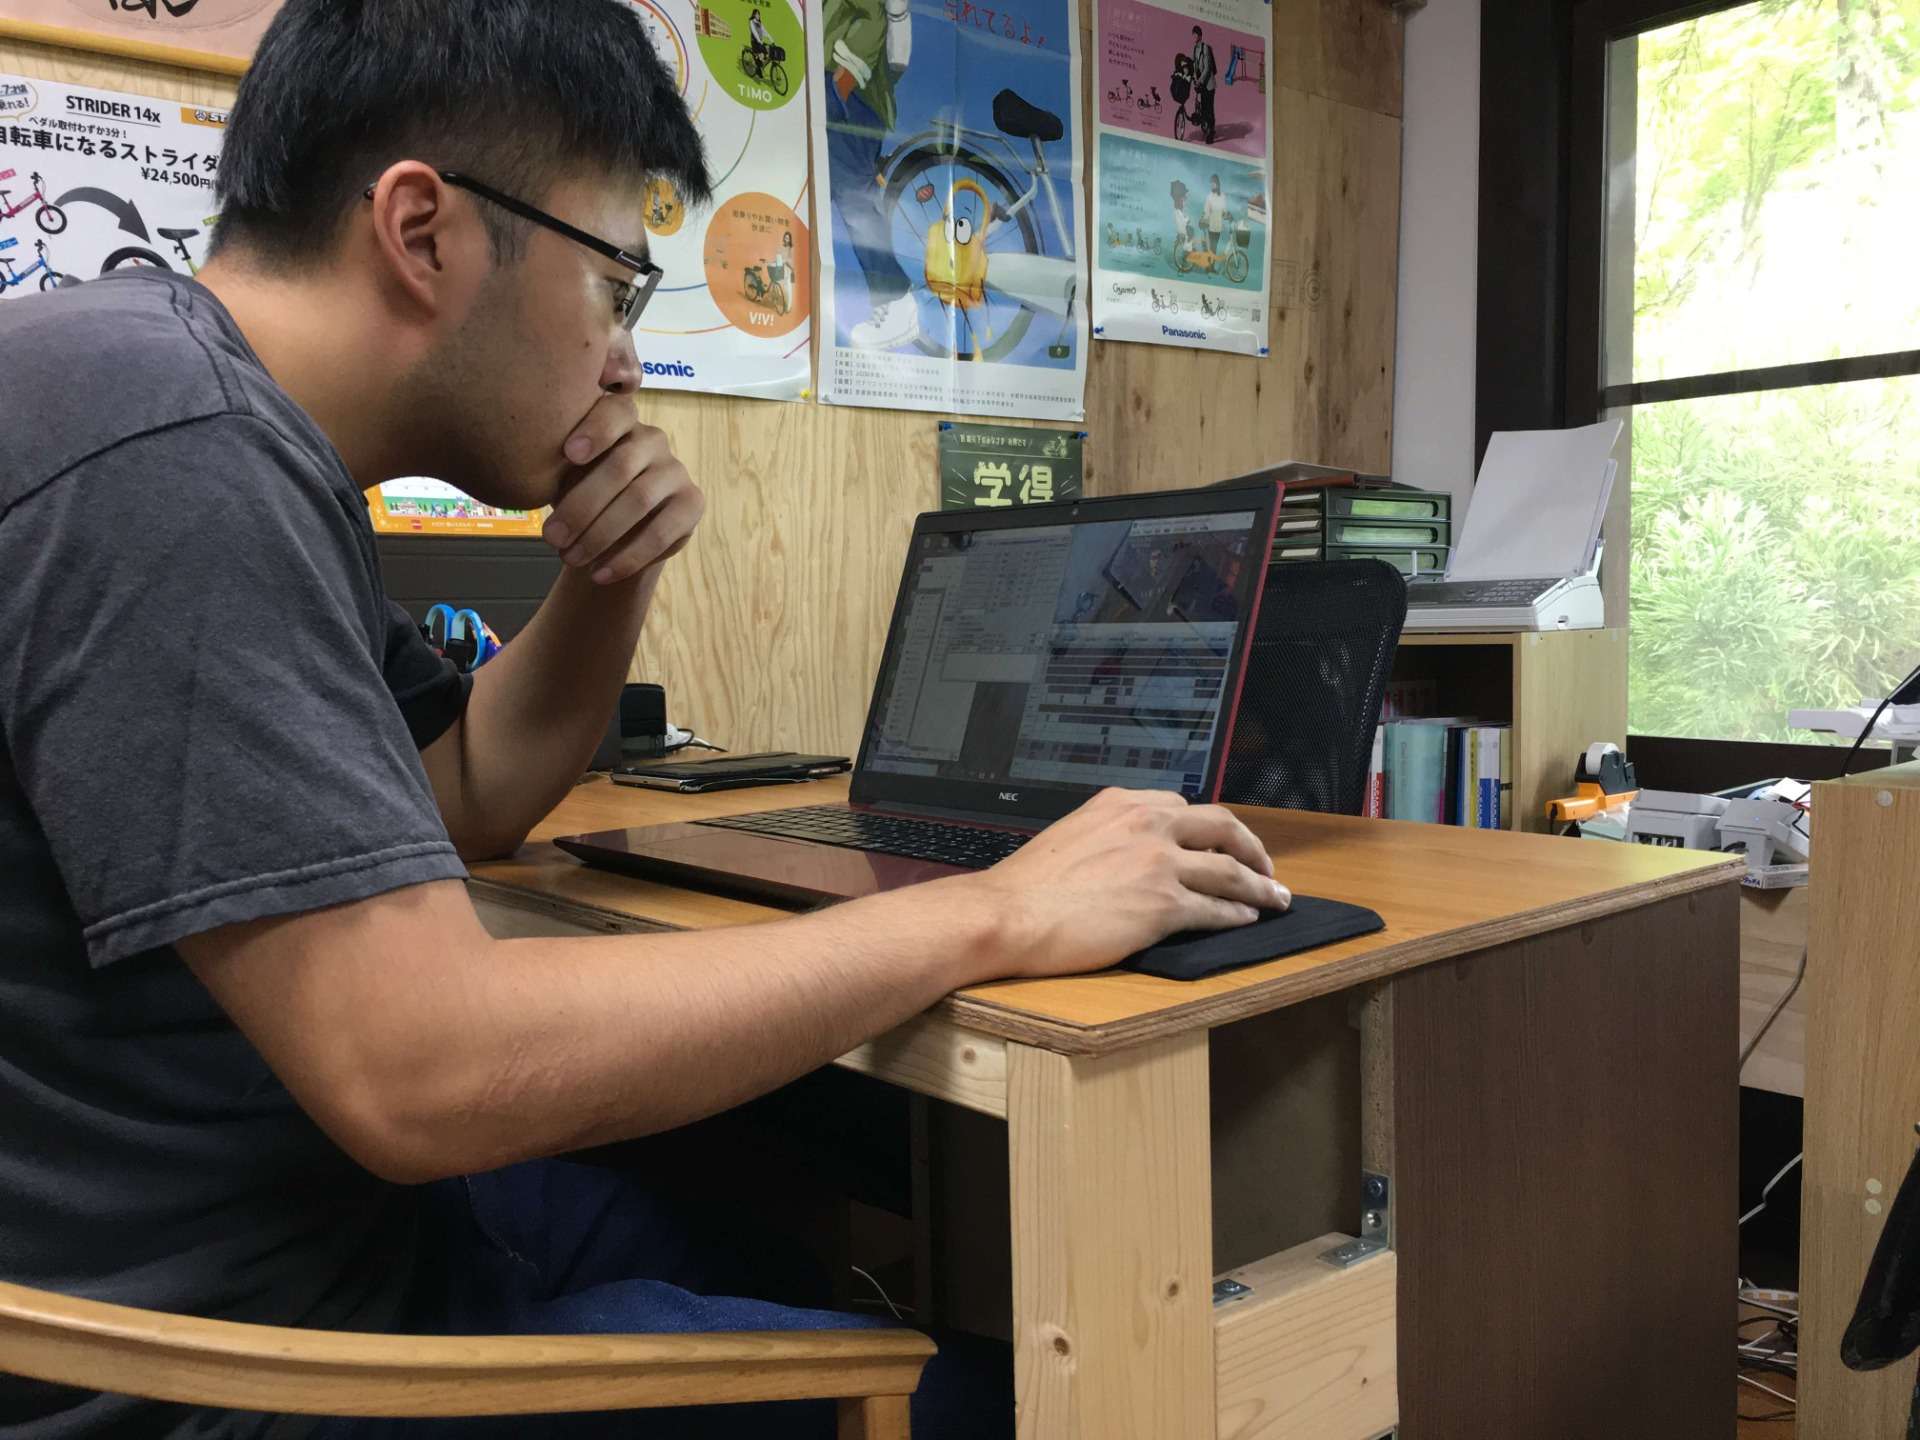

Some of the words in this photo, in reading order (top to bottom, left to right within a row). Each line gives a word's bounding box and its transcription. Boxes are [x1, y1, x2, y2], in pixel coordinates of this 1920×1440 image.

[66, 95, 131, 118] STRIDER
[134, 106, 161, 123] 14x
[1162, 325, 1207, 340] Panasonic
[640, 360, 695, 377] sonic
[998, 791, 1019, 802] NEC
